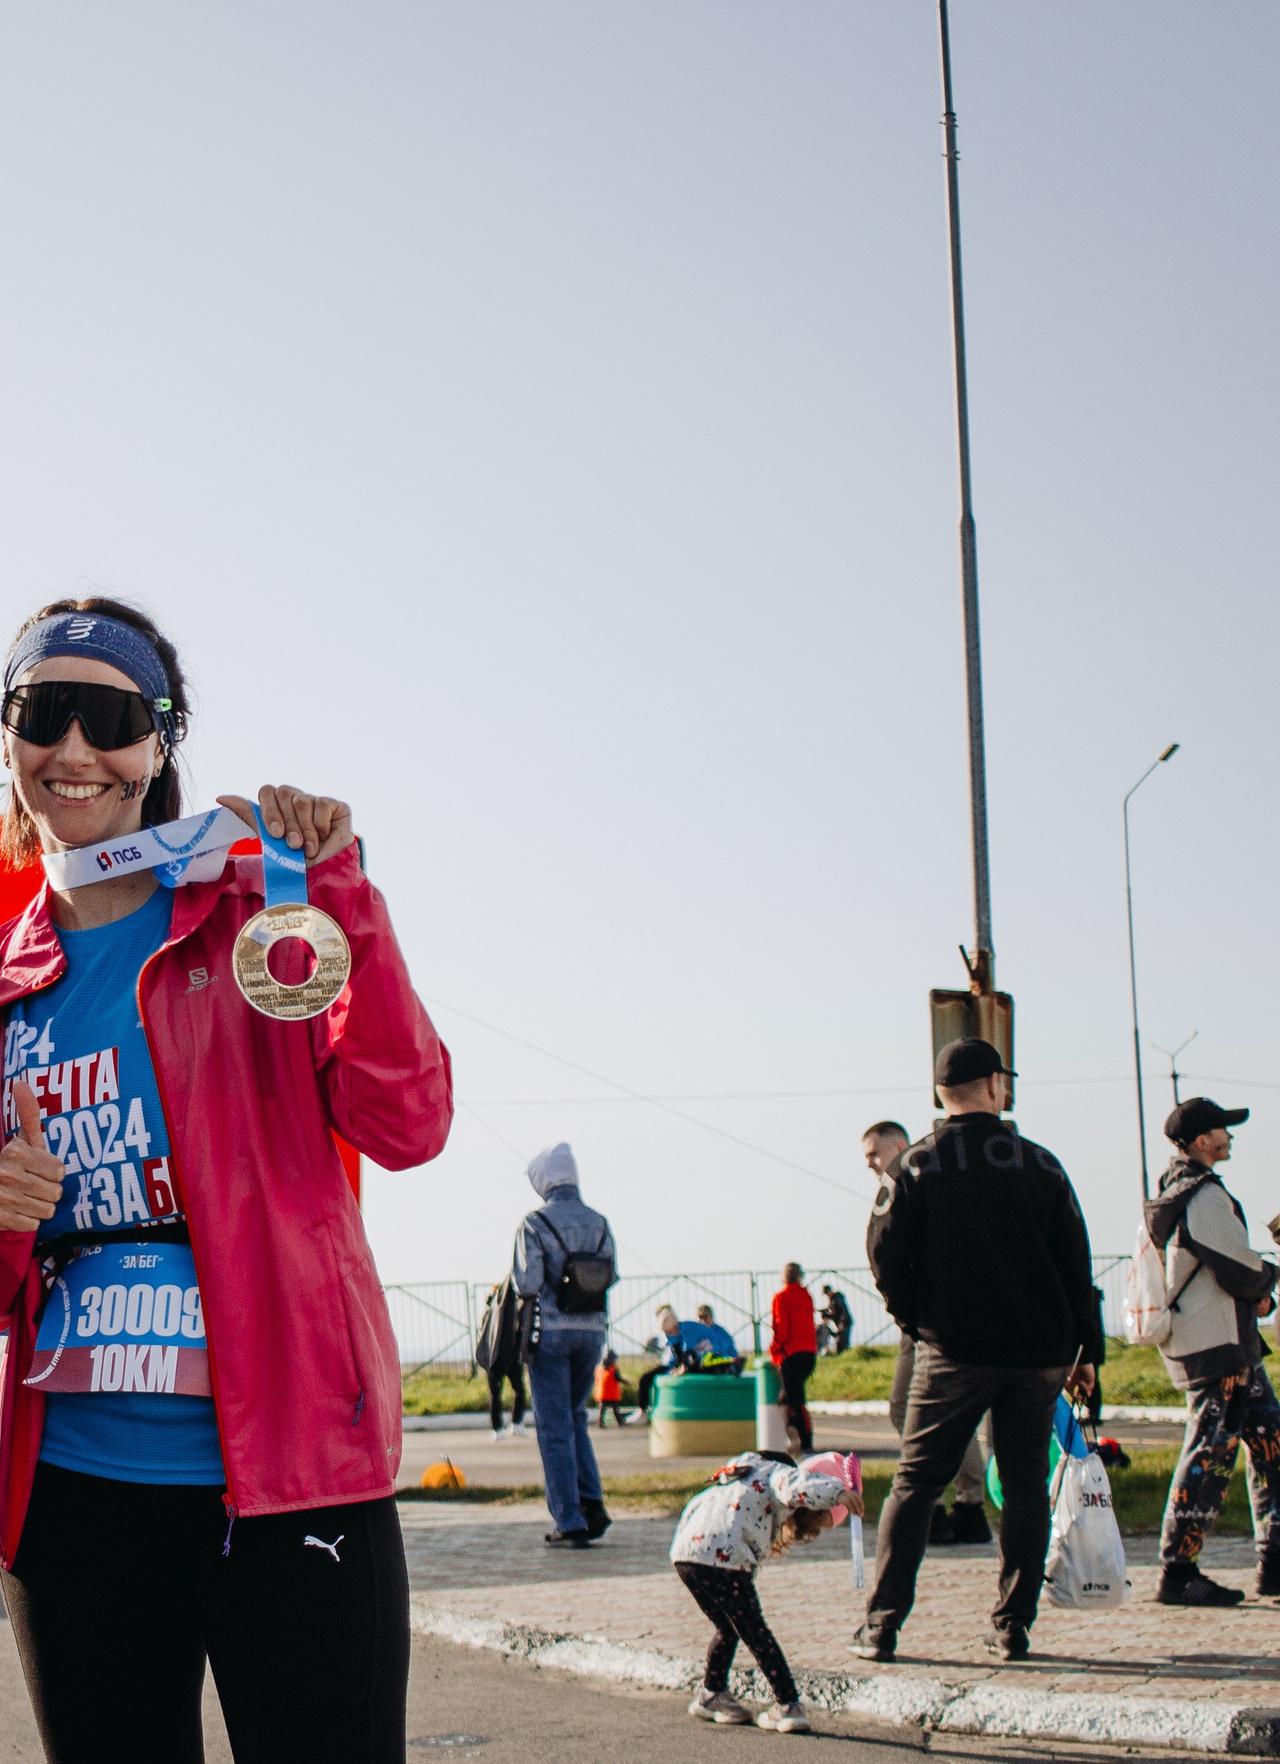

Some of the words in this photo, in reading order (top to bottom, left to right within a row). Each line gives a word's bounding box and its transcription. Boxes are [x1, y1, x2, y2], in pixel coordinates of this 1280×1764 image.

[112, 846, 143, 865] ПСБ
[4, 1017, 55, 1076] 024
[77, 1284, 207, 1339] 30009
